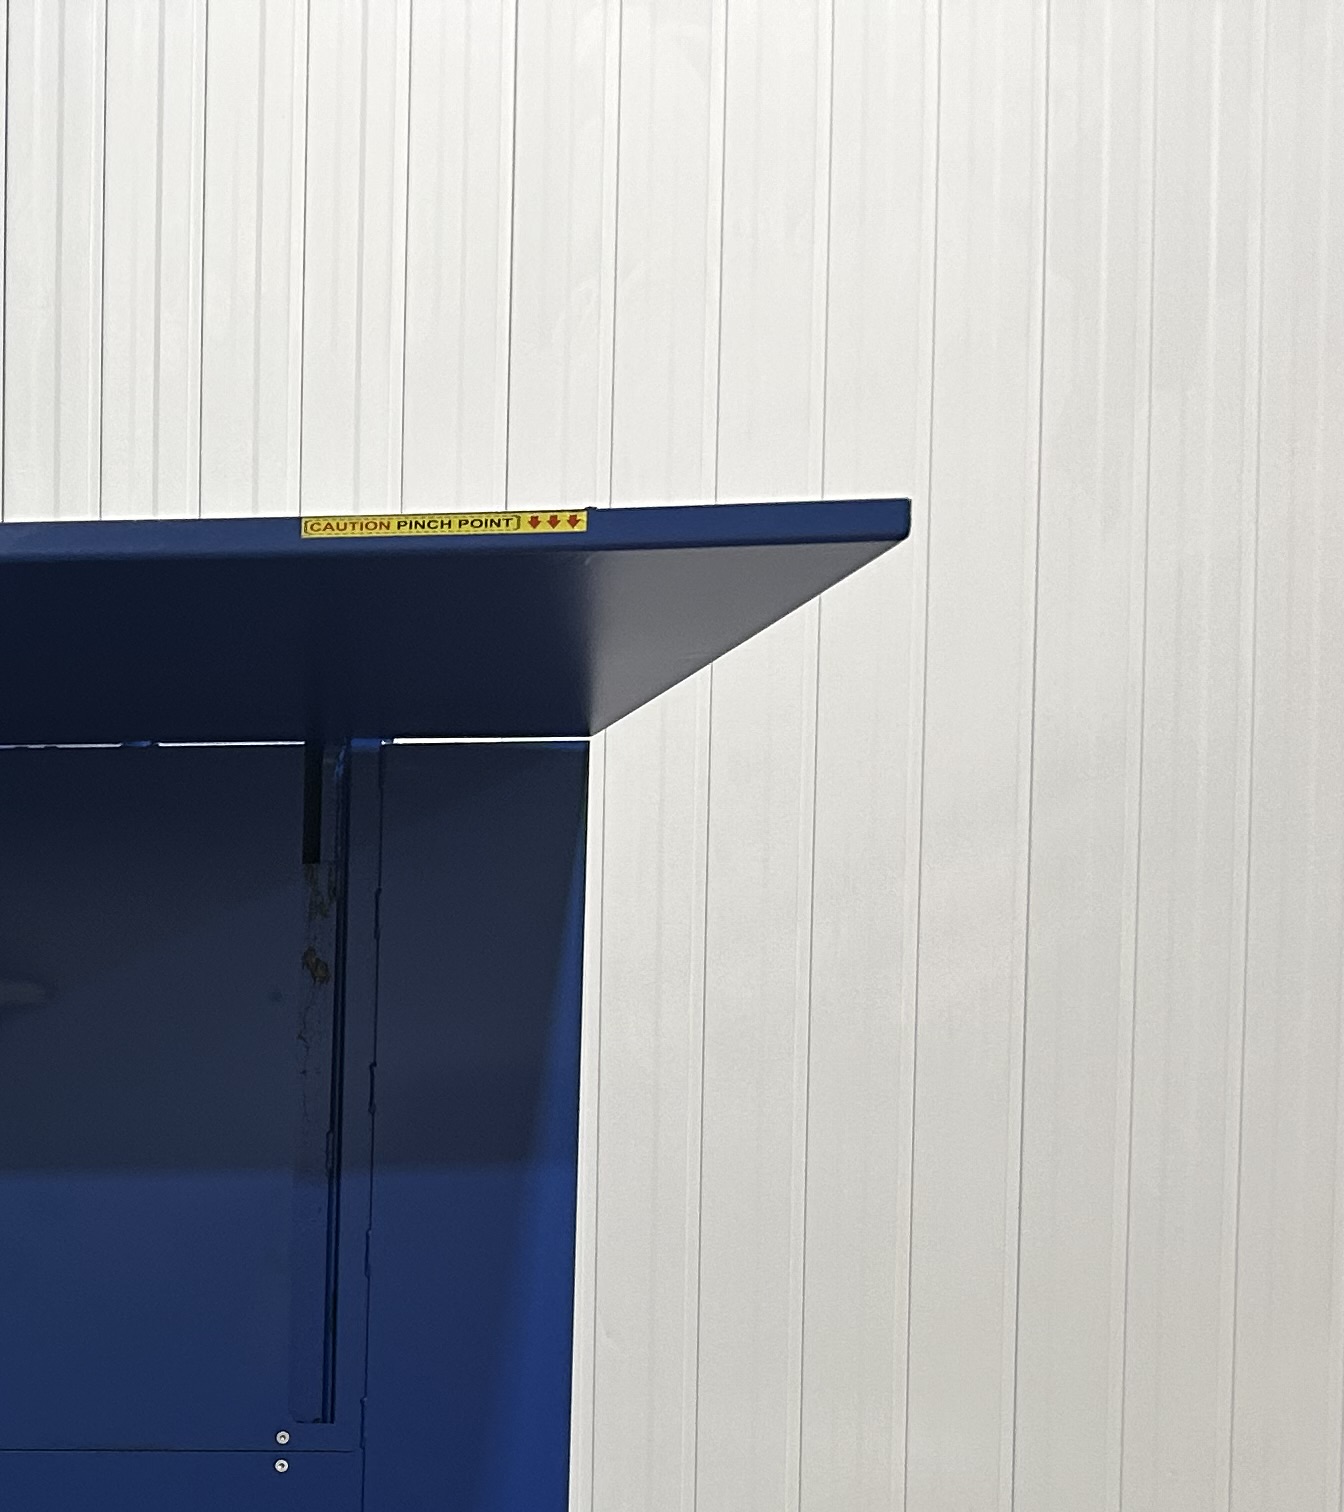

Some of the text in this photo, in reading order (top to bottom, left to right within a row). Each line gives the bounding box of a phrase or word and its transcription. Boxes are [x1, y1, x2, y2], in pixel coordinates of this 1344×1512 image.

[310, 517, 513, 532] CAUTION PINCH POINT
